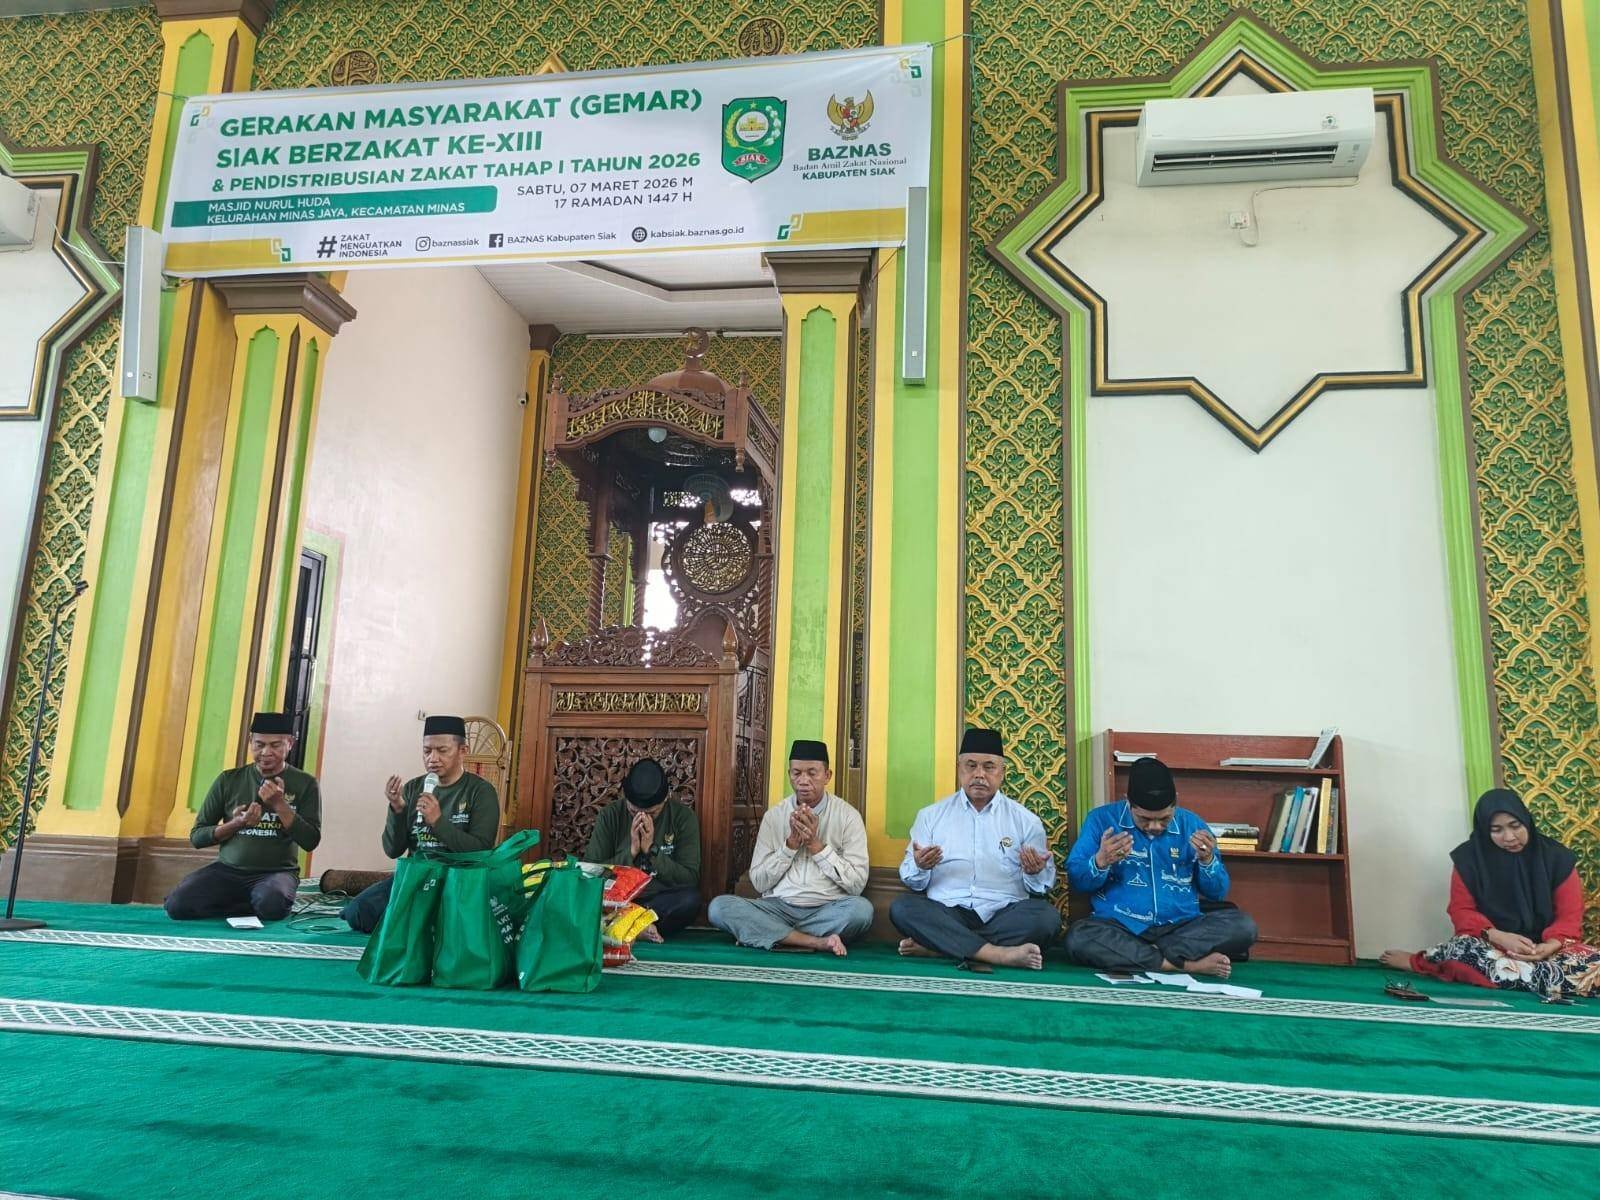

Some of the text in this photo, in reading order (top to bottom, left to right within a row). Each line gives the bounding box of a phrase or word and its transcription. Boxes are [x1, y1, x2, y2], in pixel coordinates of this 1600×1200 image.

[220, 87, 702, 137] GERAKAN MASYARAKAT (GEMAR)
[216, 131, 542, 169] SIAK BERZAKAT KE-XIII
[808, 142, 892, 162] BAZNAS
[739, 154, 761, 163] SIAK
[793, 157, 907, 172] Badan Amil Zakat Nasional
[212, 152, 701, 193] & PENDISTRIBUSIAN ZAKAT TAHAP I TAHUN 2026
[802, 167, 896, 181] KABUPATEN SIAK
[517, 176, 694, 198] SABTU, 07 MARET 2026 M
[208, 197, 331, 213] MASJID NURUL HUDA
[554, 191, 693, 209] 17 RAMADAN 1447 H
[207, 202, 466, 225] KELURAHAN MINAS JAYA, KECAMATAN MINAS
[340, 233, 371, 242] ZAKAT
[507, 230, 617, 245] BAZNAS Kabupaten Siak
[650, 225, 745, 240] kabsiak.baznas.go.id
[340, 240, 402, 250] MENGUATKAN
[431, 238, 480, 248] baznassiak
[339, 249, 388, 258] INDONESIA
